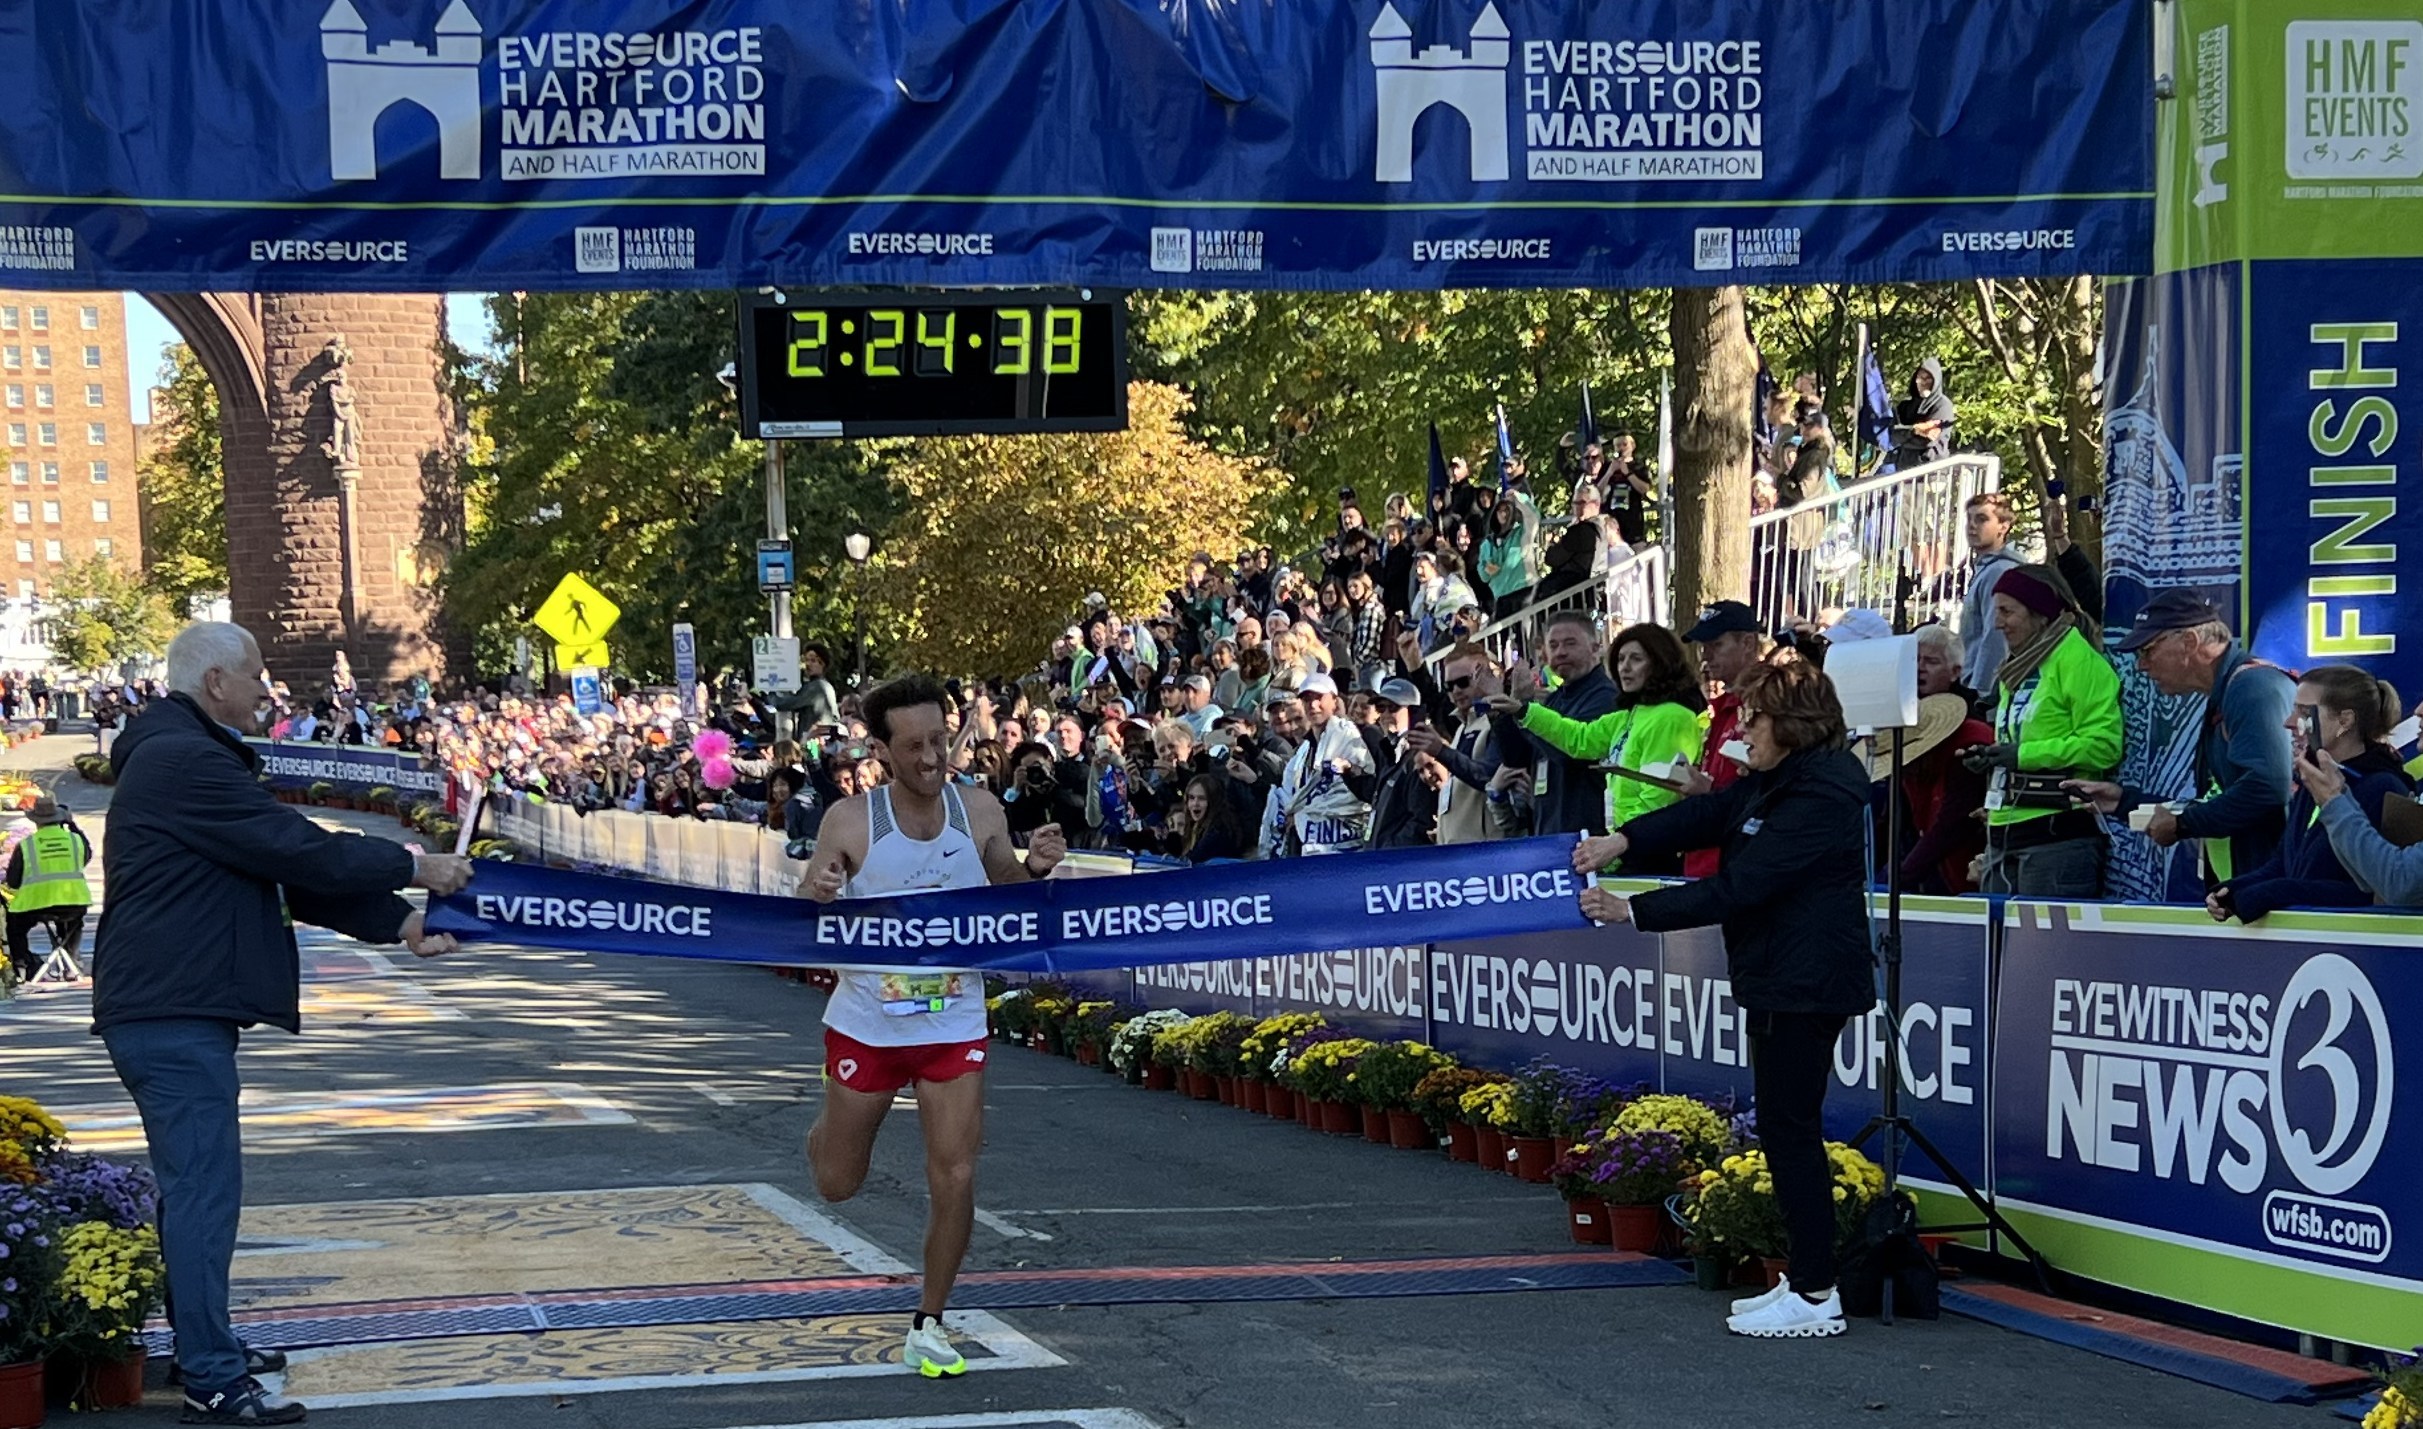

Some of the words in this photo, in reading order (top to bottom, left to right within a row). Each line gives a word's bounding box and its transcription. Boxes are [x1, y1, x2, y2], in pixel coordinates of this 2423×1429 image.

[499, 28, 762, 69] EVERSOURCE
[1524, 41, 1761, 75] EVERSOURCE
[2306, 39, 2409, 93] HMF
[500, 65, 764, 106] HARTFORD
[1525, 77, 1761, 110] HARTFORD
[502, 103, 764, 145] MARATHON
[2305, 97, 2409, 137] EVENTS
[1527, 113, 1761, 147] MARATHON
[508, 156, 555, 175] AND
[563, 153, 620, 174] HALF
[627, 151, 758, 172] MARATHON
[1533, 157, 1578, 176] AND
[1584, 157, 1631, 176] HALF
[1639, 157, 1756, 176] MARATHON
[0, 226, 73, 242] HARTFORD
[581, 231, 614, 248] HMF
[624, 228, 694, 242] HARTFORD
[849, 233, 993, 254] EVERSOURCE
[1156, 233, 1186, 249] HMF
[1196, 229, 1264, 245] HARTFORD
[1700, 232, 1728, 247] HMF
[1736, 228, 1800, 241] HARTFORD
[1943, 230, 2074, 251] EVERSOURCE
[0, 241, 74, 255] MARATHON
[250, 240, 407, 262] EVERSOURCE
[624, 242, 694, 255] MARATHON
[1196, 244, 1263, 257] MARATHON
[1413, 239, 1551, 261] EVERSOURCE
[1736, 241, 1800, 254] MARATHON
[0, 255, 74, 270] FOUNDATION
[624, 255, 695, 269] FOUNDATION
[1196, 257, 1263, 271] FOUNDATION
[1736, 253, 1799, 267] FOUNDATION
[2308, 321, 2398, 657] FINISH
[272, 754, 337, 779] EVERSOURCE
[1364, 868, 1573, 916] EVERSOURCE
[476, 895, 711, 937] EVERSOURCE
[1063, 894, 1273, 941] EVERSOURCE
[816, 912, 1038, 948] EVERSOURCE
[1256, 946, 1422, 1019] EVERSOURCE
[1431, 951, 1656, 1050] EVERSOURCE
[2052, 978, 2270, 1054] EYEWITNESS
[1663, 972, 1973, 1105] EVEURCE
[2287, 976, 2365, 1172] 3
[2047, 1048, 2268, 1194] NEWS
[2271, 1203, 2381, 1249] wfsb.com
